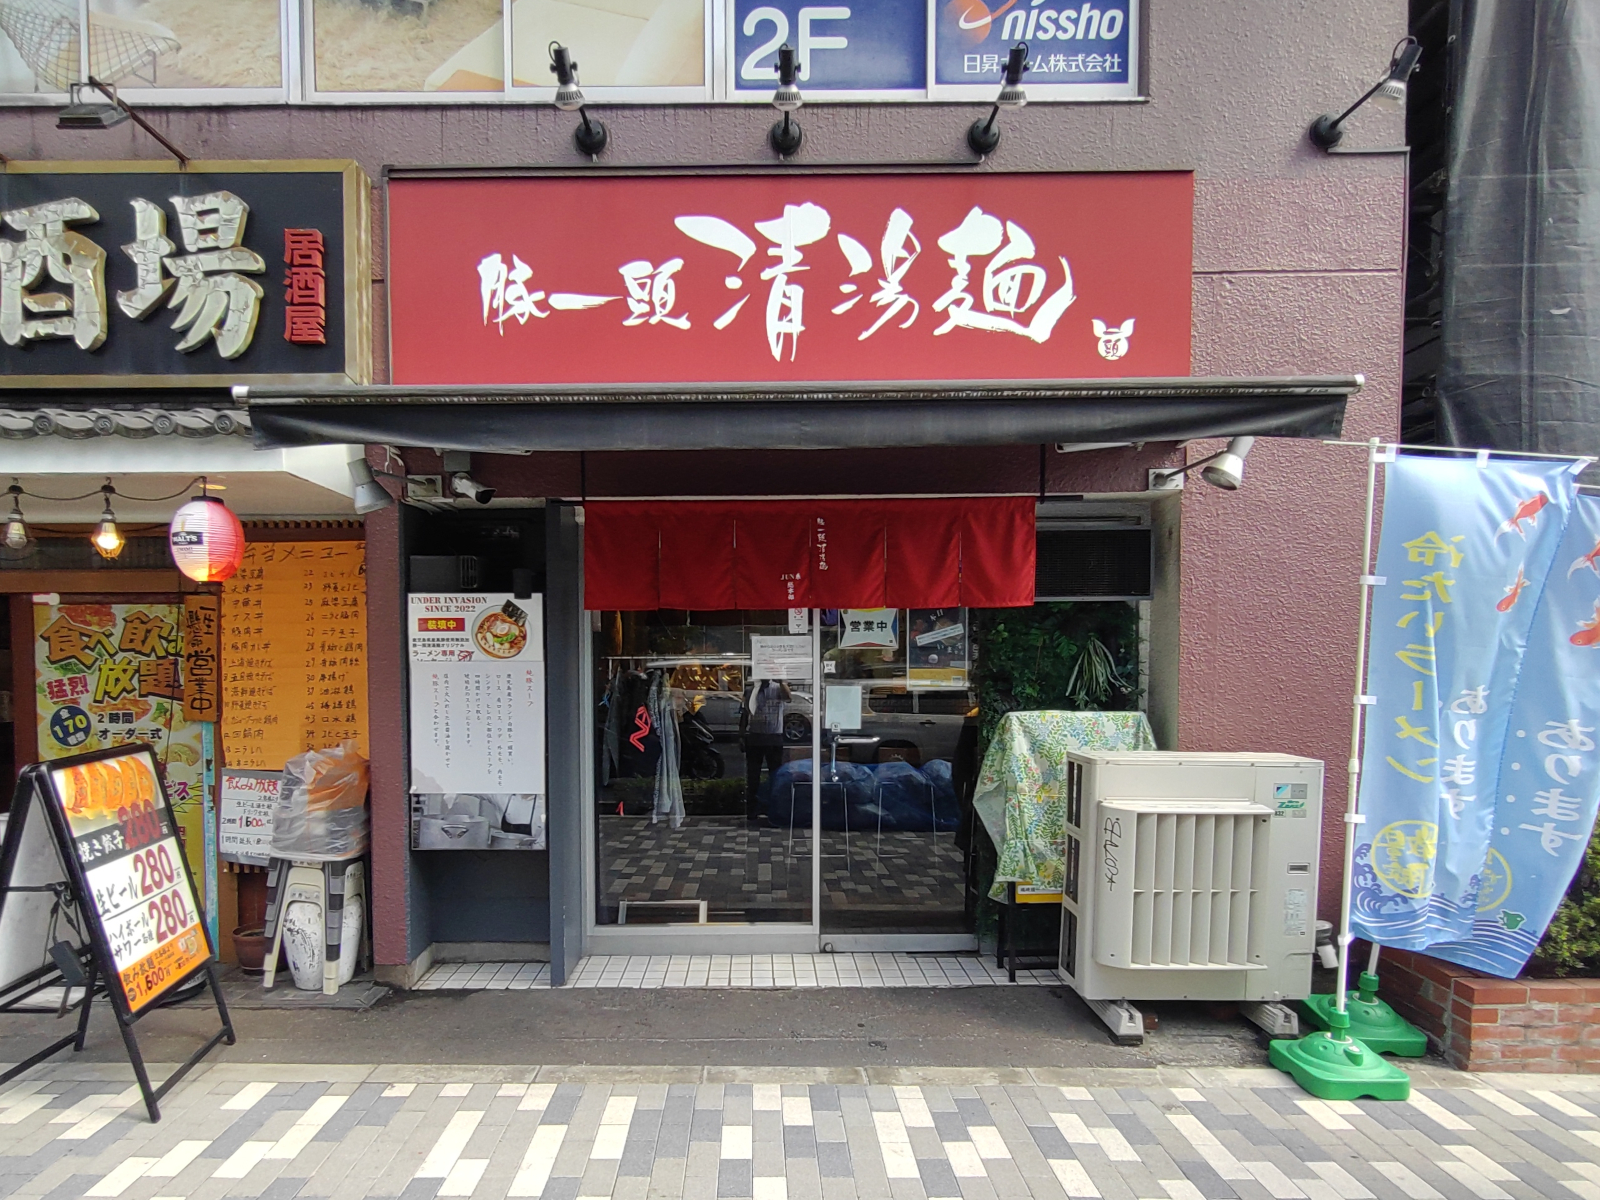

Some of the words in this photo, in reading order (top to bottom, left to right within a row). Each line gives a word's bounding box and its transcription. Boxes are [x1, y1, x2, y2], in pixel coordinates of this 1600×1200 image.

[1001, 0, 1123, 40] nissho
[741, 6, 852, 81] 2F
[963, 54, 1122, 74] 日昇ム株式会社
[284, 228, 326, 344] 居酒屋
[850, 620, 887, 632] 営業中
[46, 674, 91, 700] 猛烈
[53, 714, 87, 738] 170
[97, 712, 134, 724] 2時間
[98, 727, 162, 740] オーダー式
[96, 876, 138, 917] 生ビール
[109, 912, 149, 942] ハイボール
